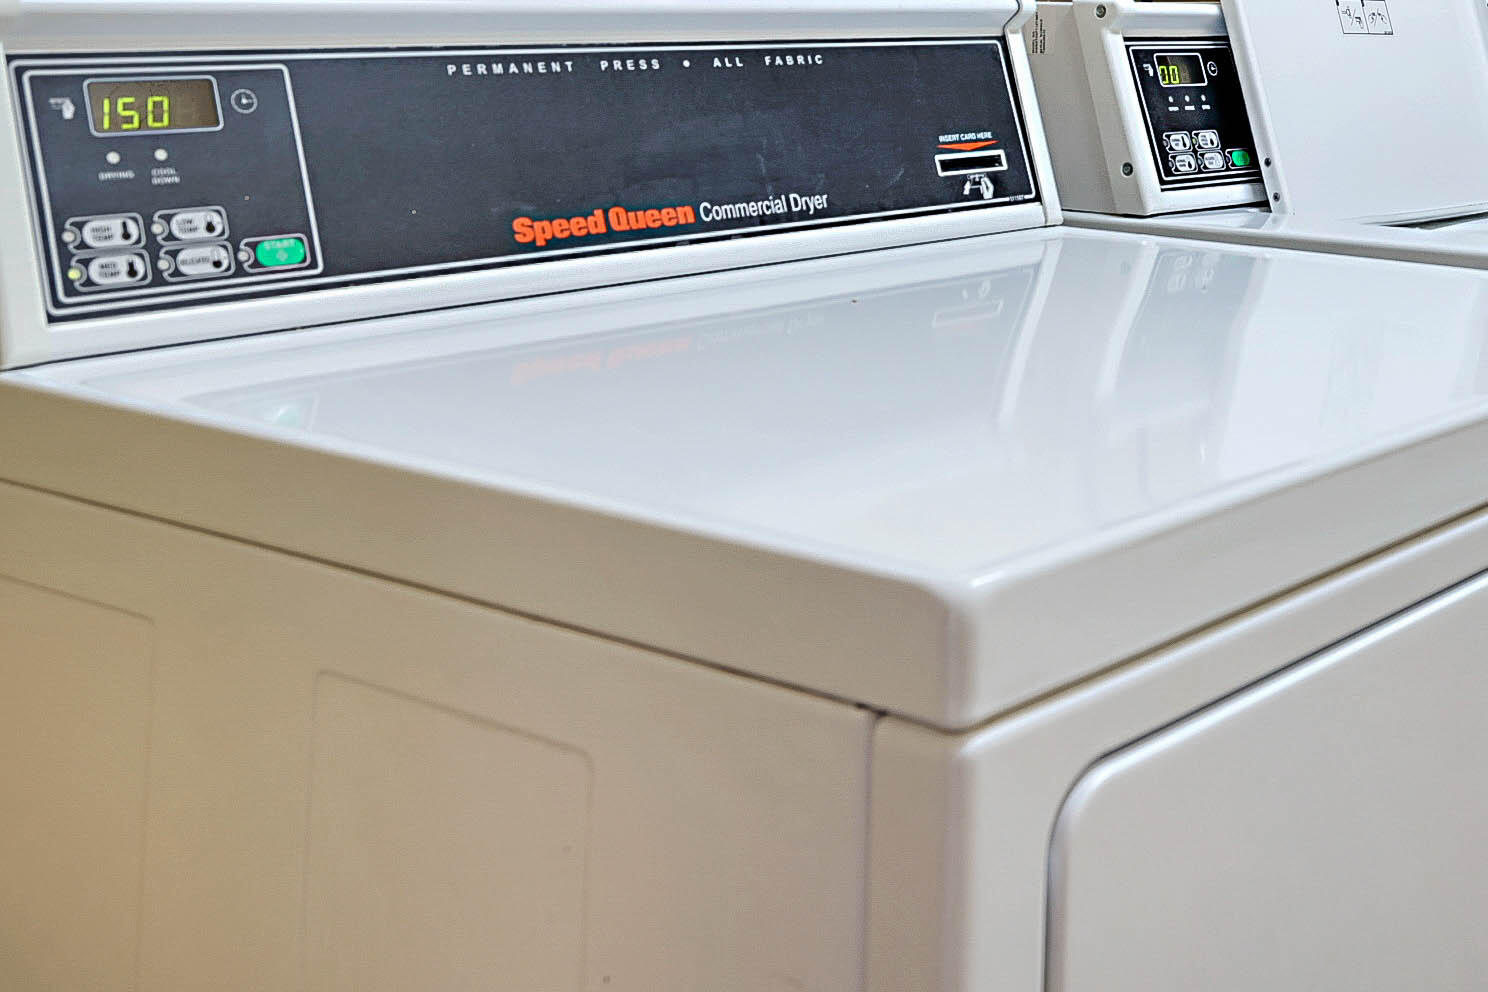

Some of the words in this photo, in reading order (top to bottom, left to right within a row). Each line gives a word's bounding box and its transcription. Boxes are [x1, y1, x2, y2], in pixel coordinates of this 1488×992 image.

[446, 61, 575, 76] PERMANENT
[600, 58, 661, 71] PRESS
[713, 55, 744, 68] ALL
[764, 54, 824, 67] FABRIC
[103, 95, 169, 130] 150
[960, 132, 977, 141] CARD
[512, 209, 607, 247] Speed
[608, 204, 696, 232] Queen
[699, 194, 788, 222] Commercial
[789, 192, 828, 219] Dryer
